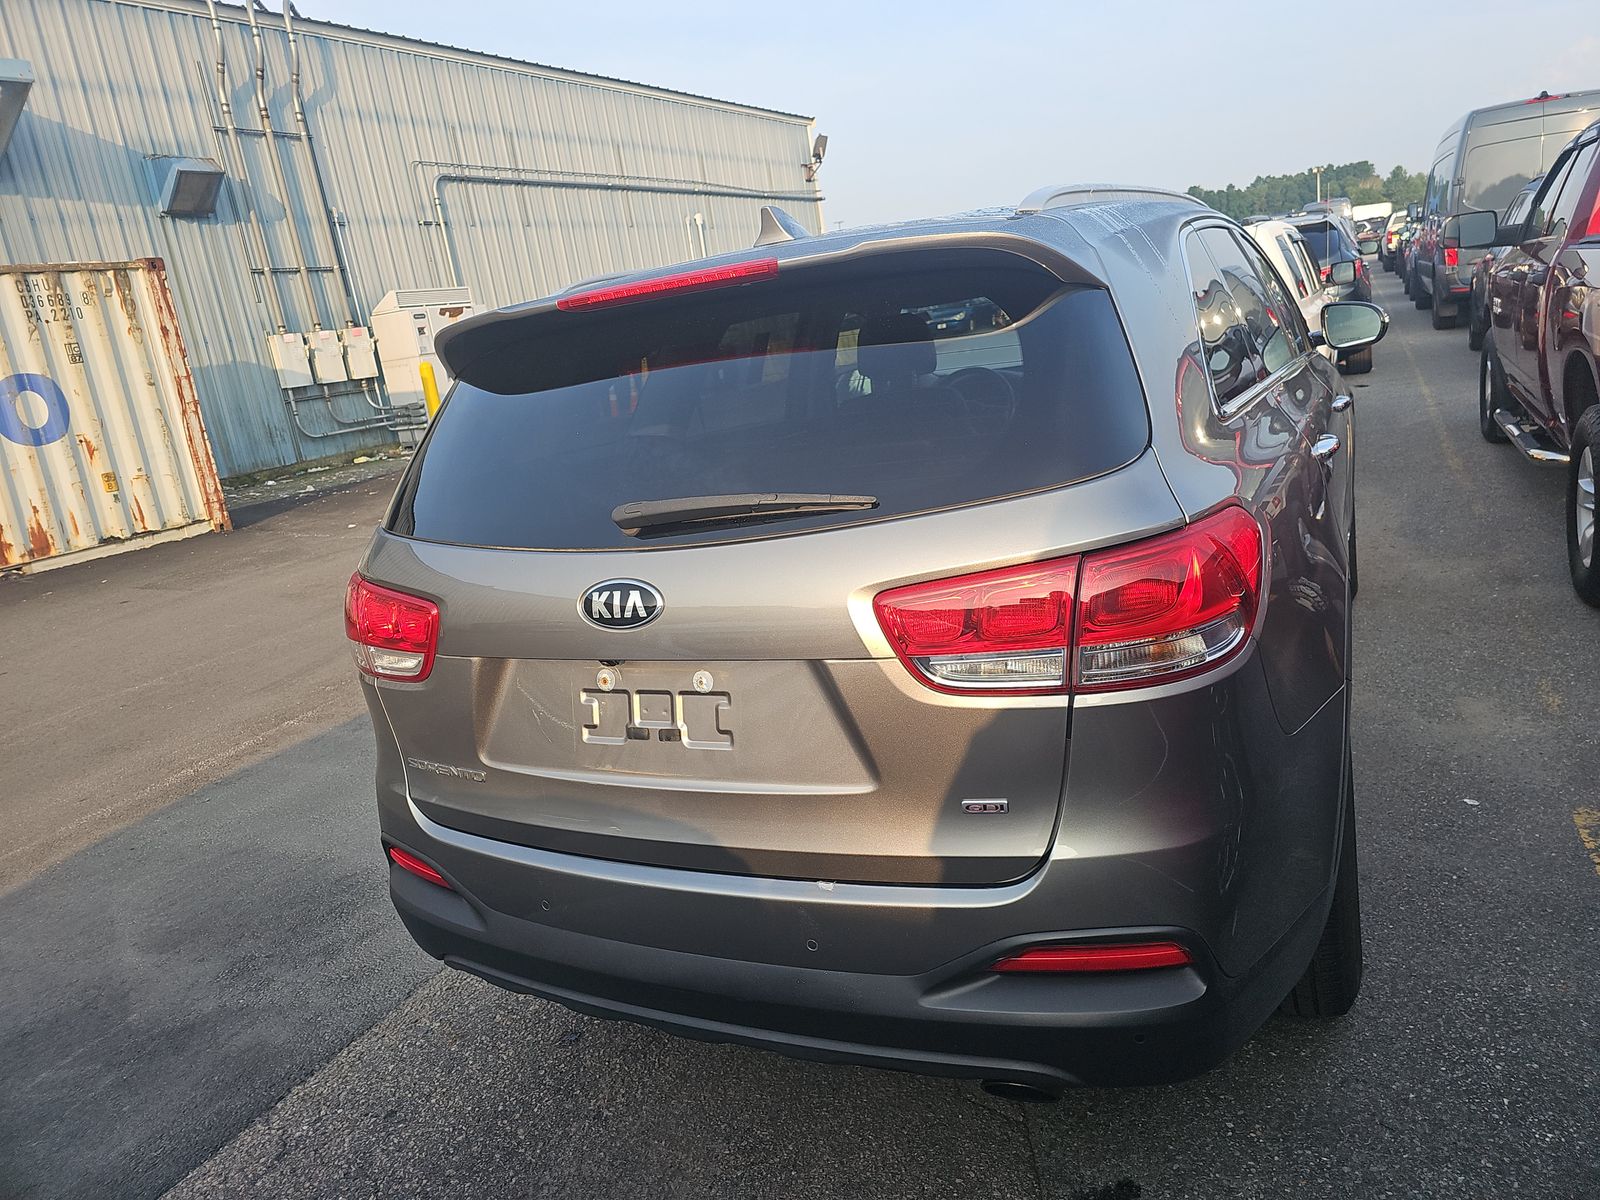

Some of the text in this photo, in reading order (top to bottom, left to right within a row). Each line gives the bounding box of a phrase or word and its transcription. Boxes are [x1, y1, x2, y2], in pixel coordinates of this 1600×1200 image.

[15, 279, 51, 293] CBHU
[591, 590, 648, 618] KIA
[408, 757, 487, 783] SORENTO
[964, 802, 1005, 813] GDI
